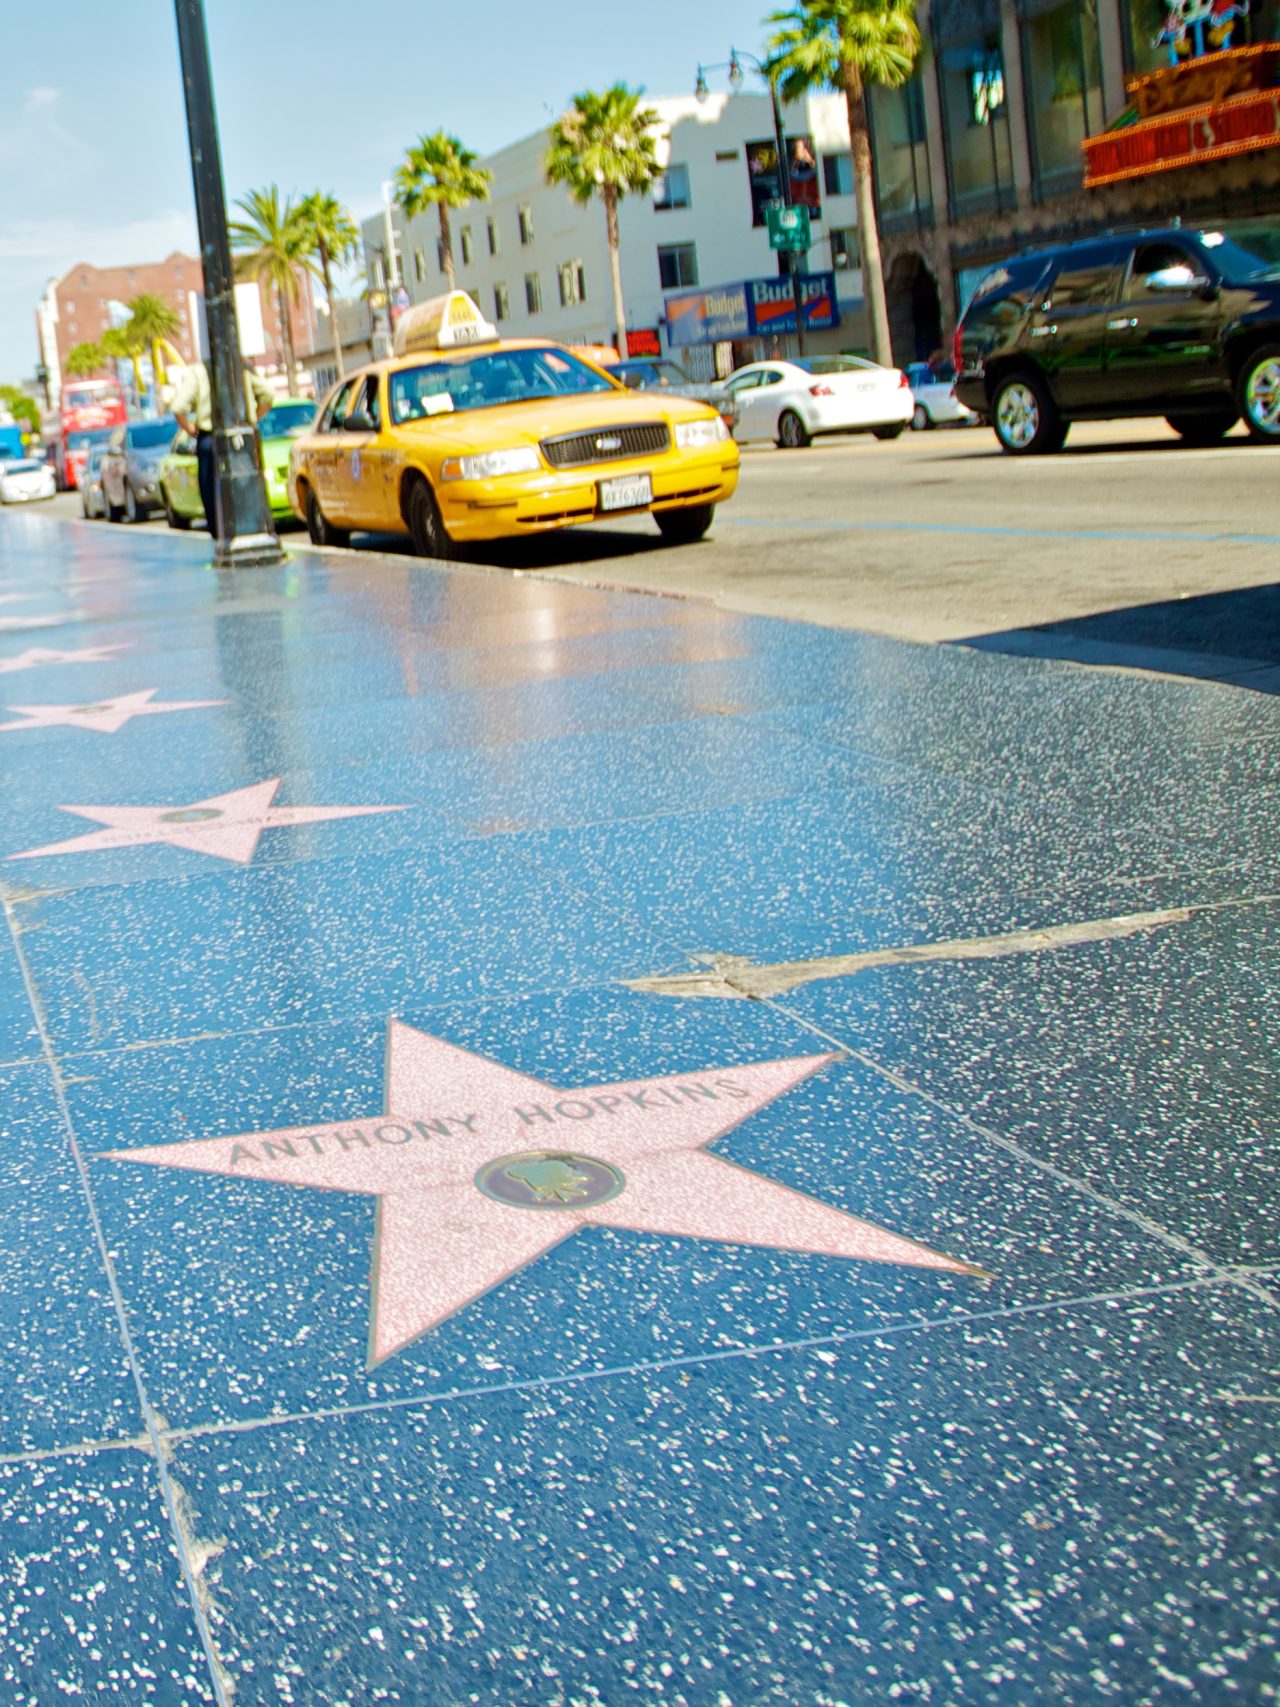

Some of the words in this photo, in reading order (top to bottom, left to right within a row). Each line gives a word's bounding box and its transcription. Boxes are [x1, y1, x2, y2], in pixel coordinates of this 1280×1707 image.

[705, 291, 744, 320] Budget
[228, 1112, 479, 1166] ANTHONY
[513, 1075, 755, 1127] HOPKINS
